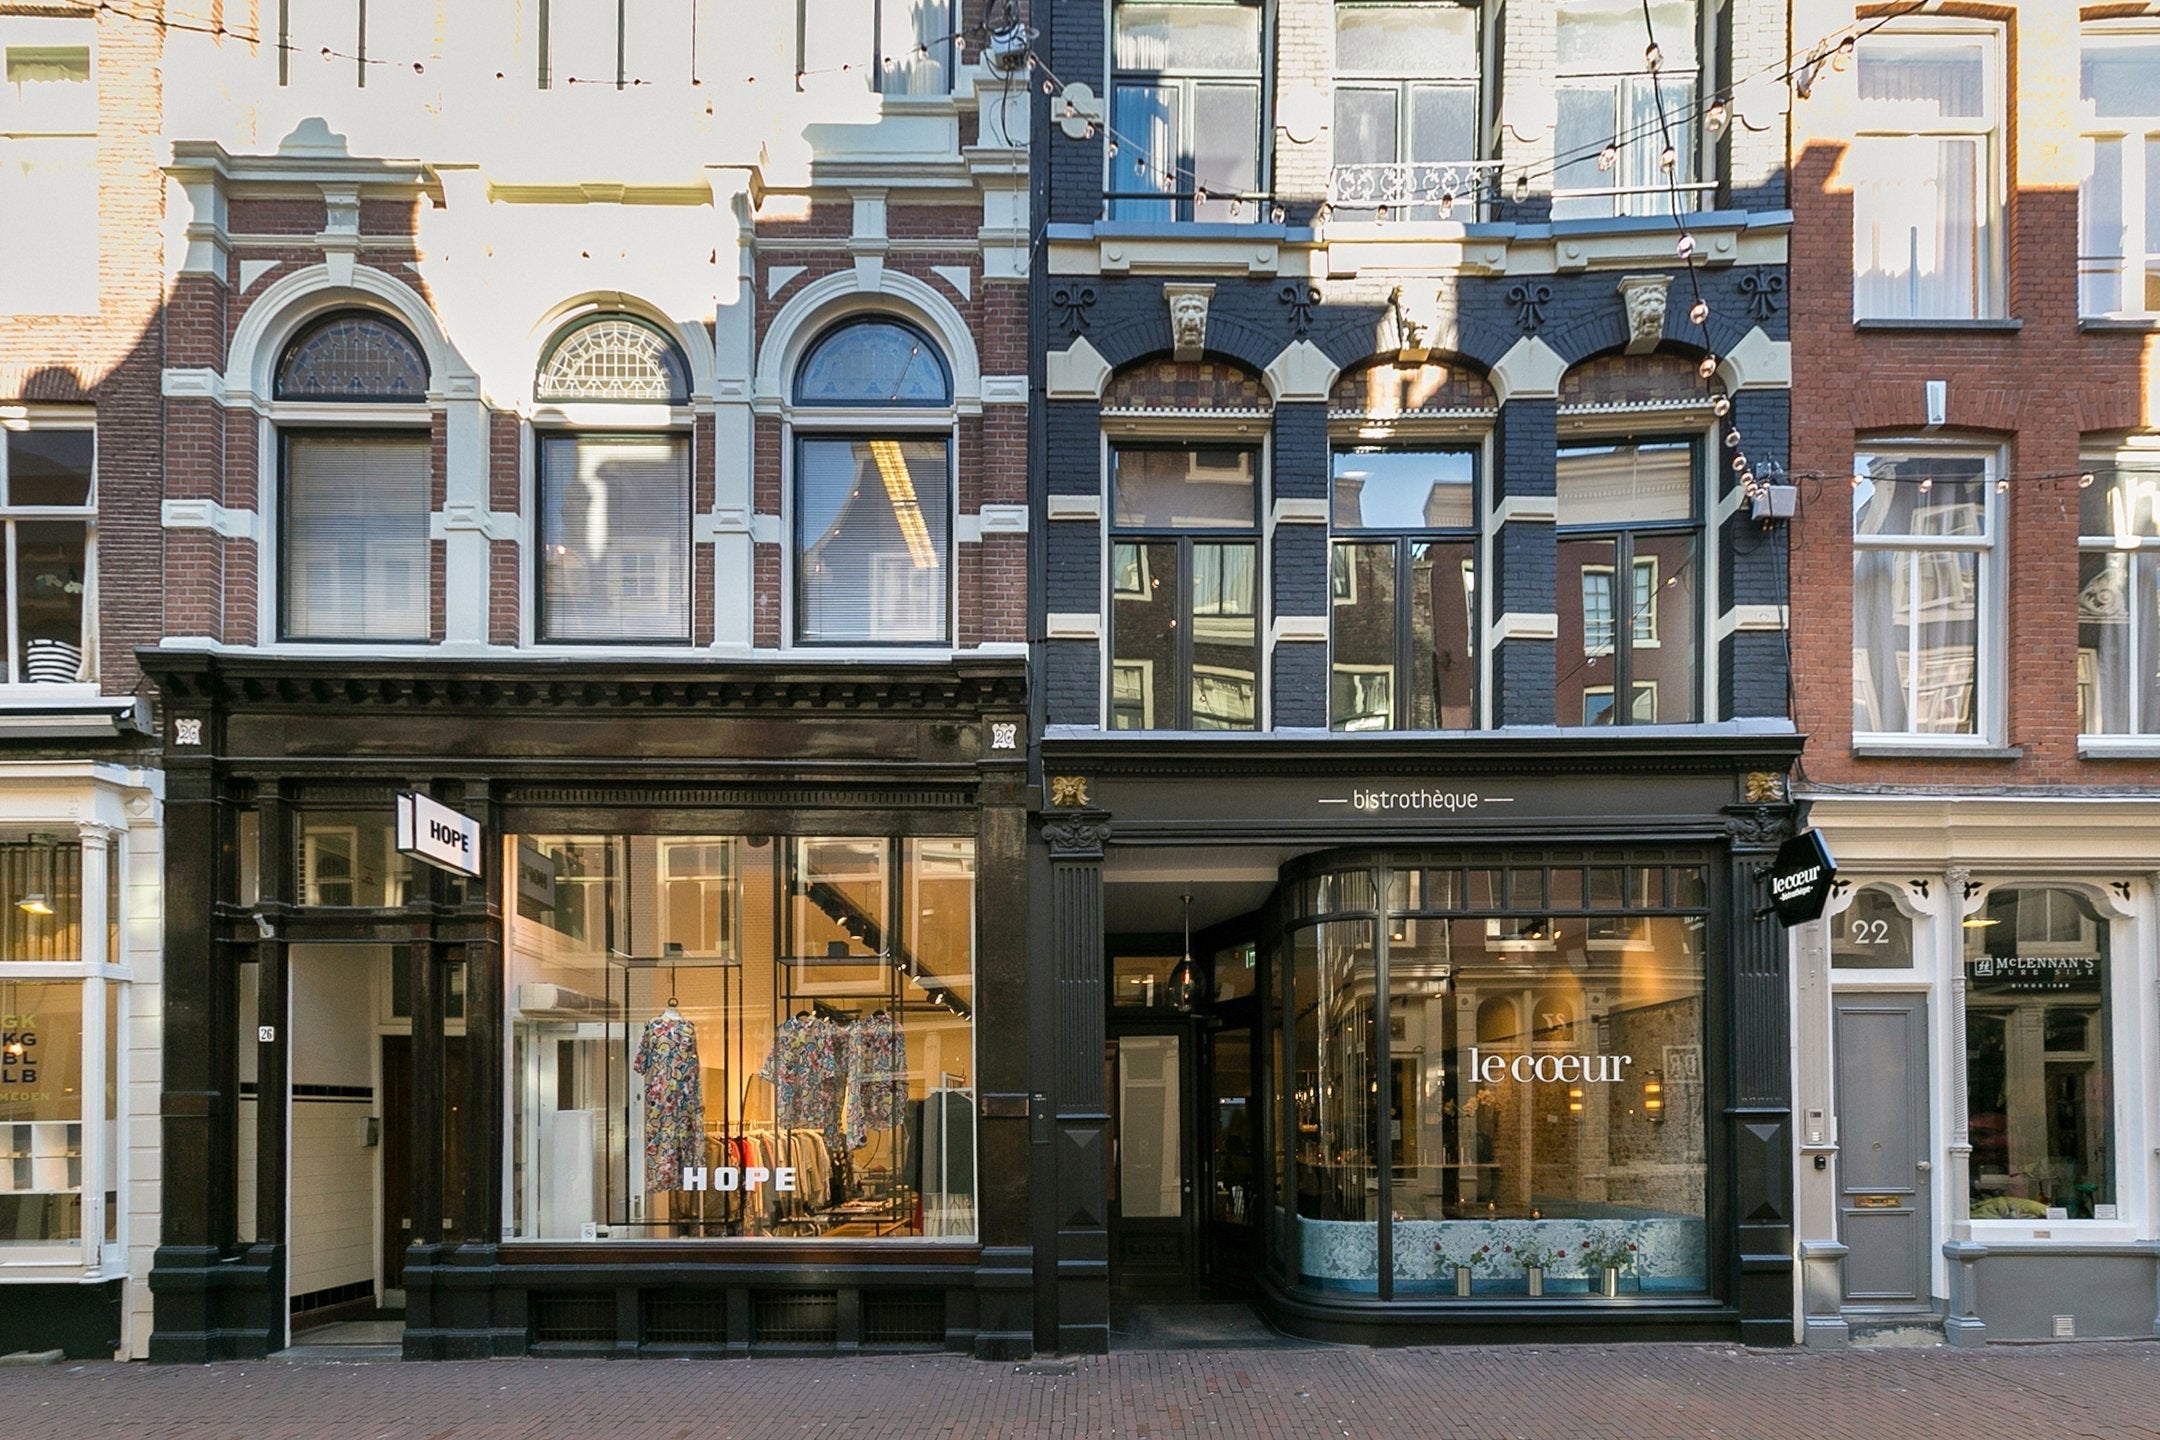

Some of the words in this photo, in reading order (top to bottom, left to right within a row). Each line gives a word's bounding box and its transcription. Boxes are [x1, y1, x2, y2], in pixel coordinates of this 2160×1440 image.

[180, 724, 198, 740] 26
[995, 729, 1013, 744] 26
[1353, 789, 1478, 812] bistrothèque
[430, 819, 469, 853] HOPE
[1851, 919, 1889, 944] 22
[260, 1028, 273, 1040] 26
[683, 1167, 797, 1191] HOPE
